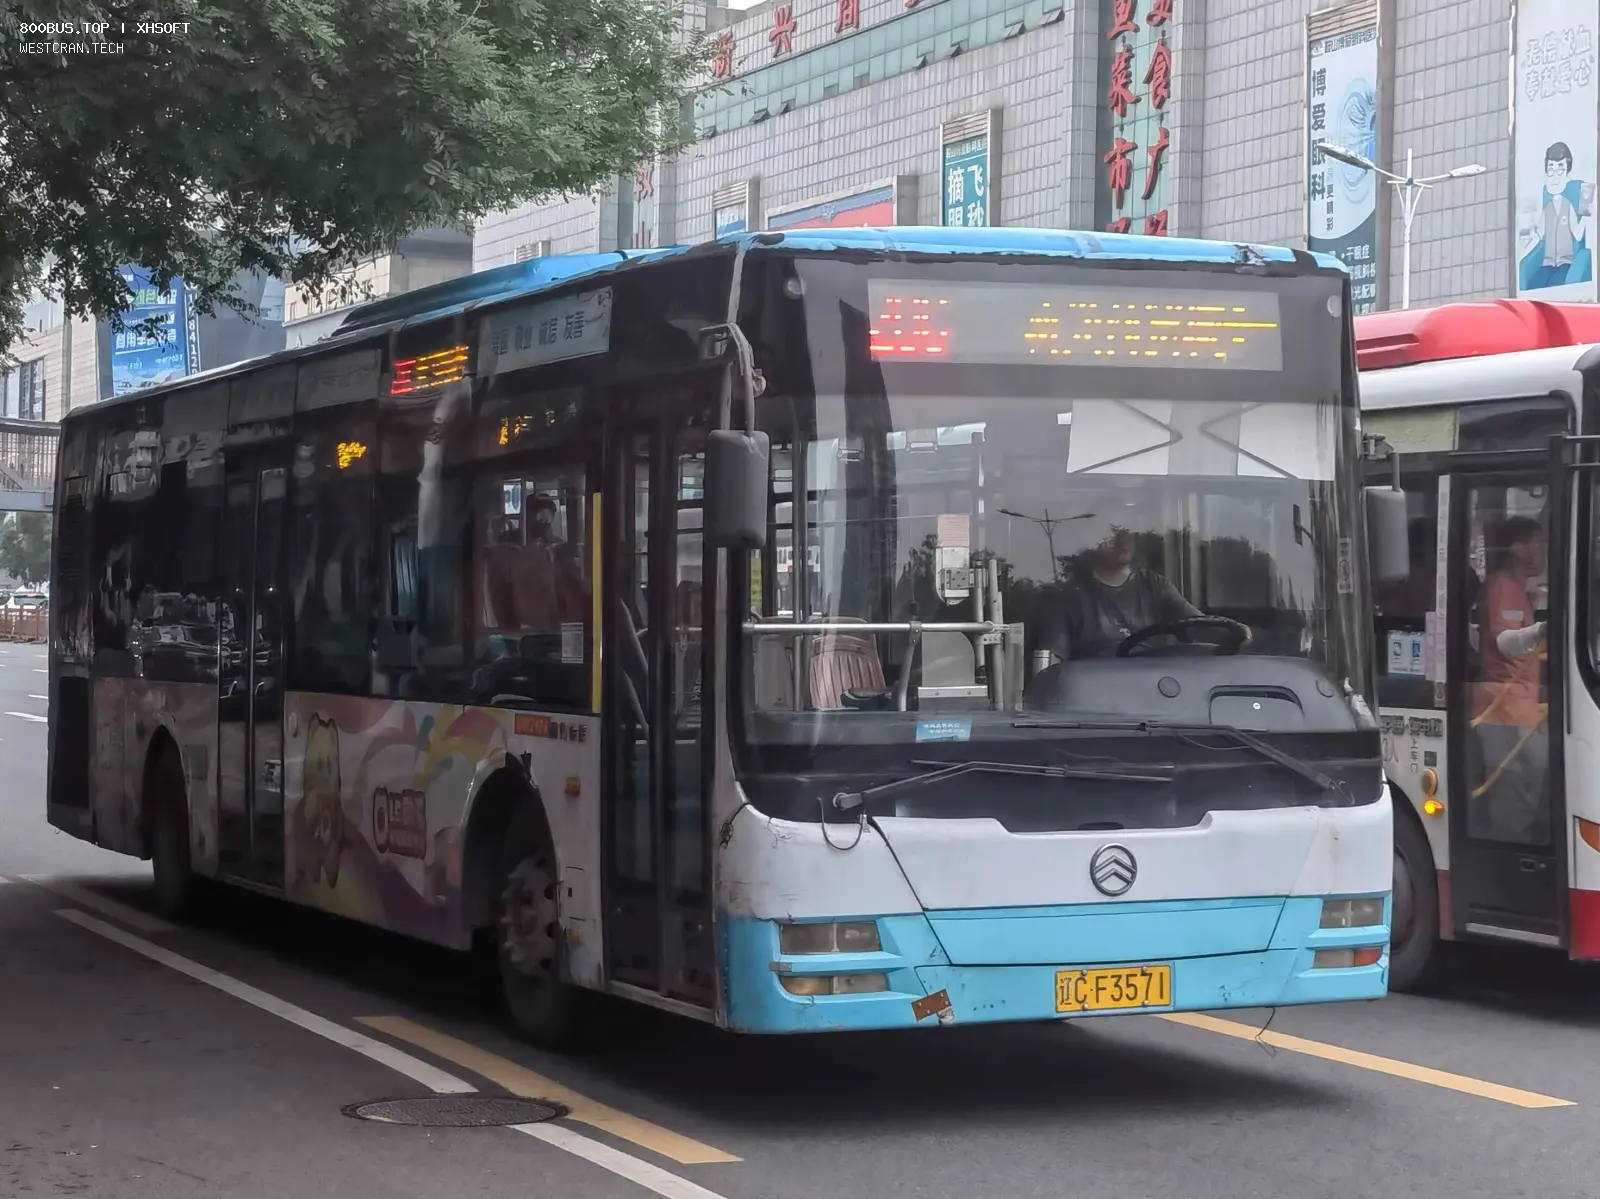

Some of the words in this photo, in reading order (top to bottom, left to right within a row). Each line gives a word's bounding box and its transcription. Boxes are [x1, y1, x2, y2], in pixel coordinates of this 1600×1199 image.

[712, 0, 919, 79] 新兴商
[1311, 67, 1327, 202] 博爱眼科
